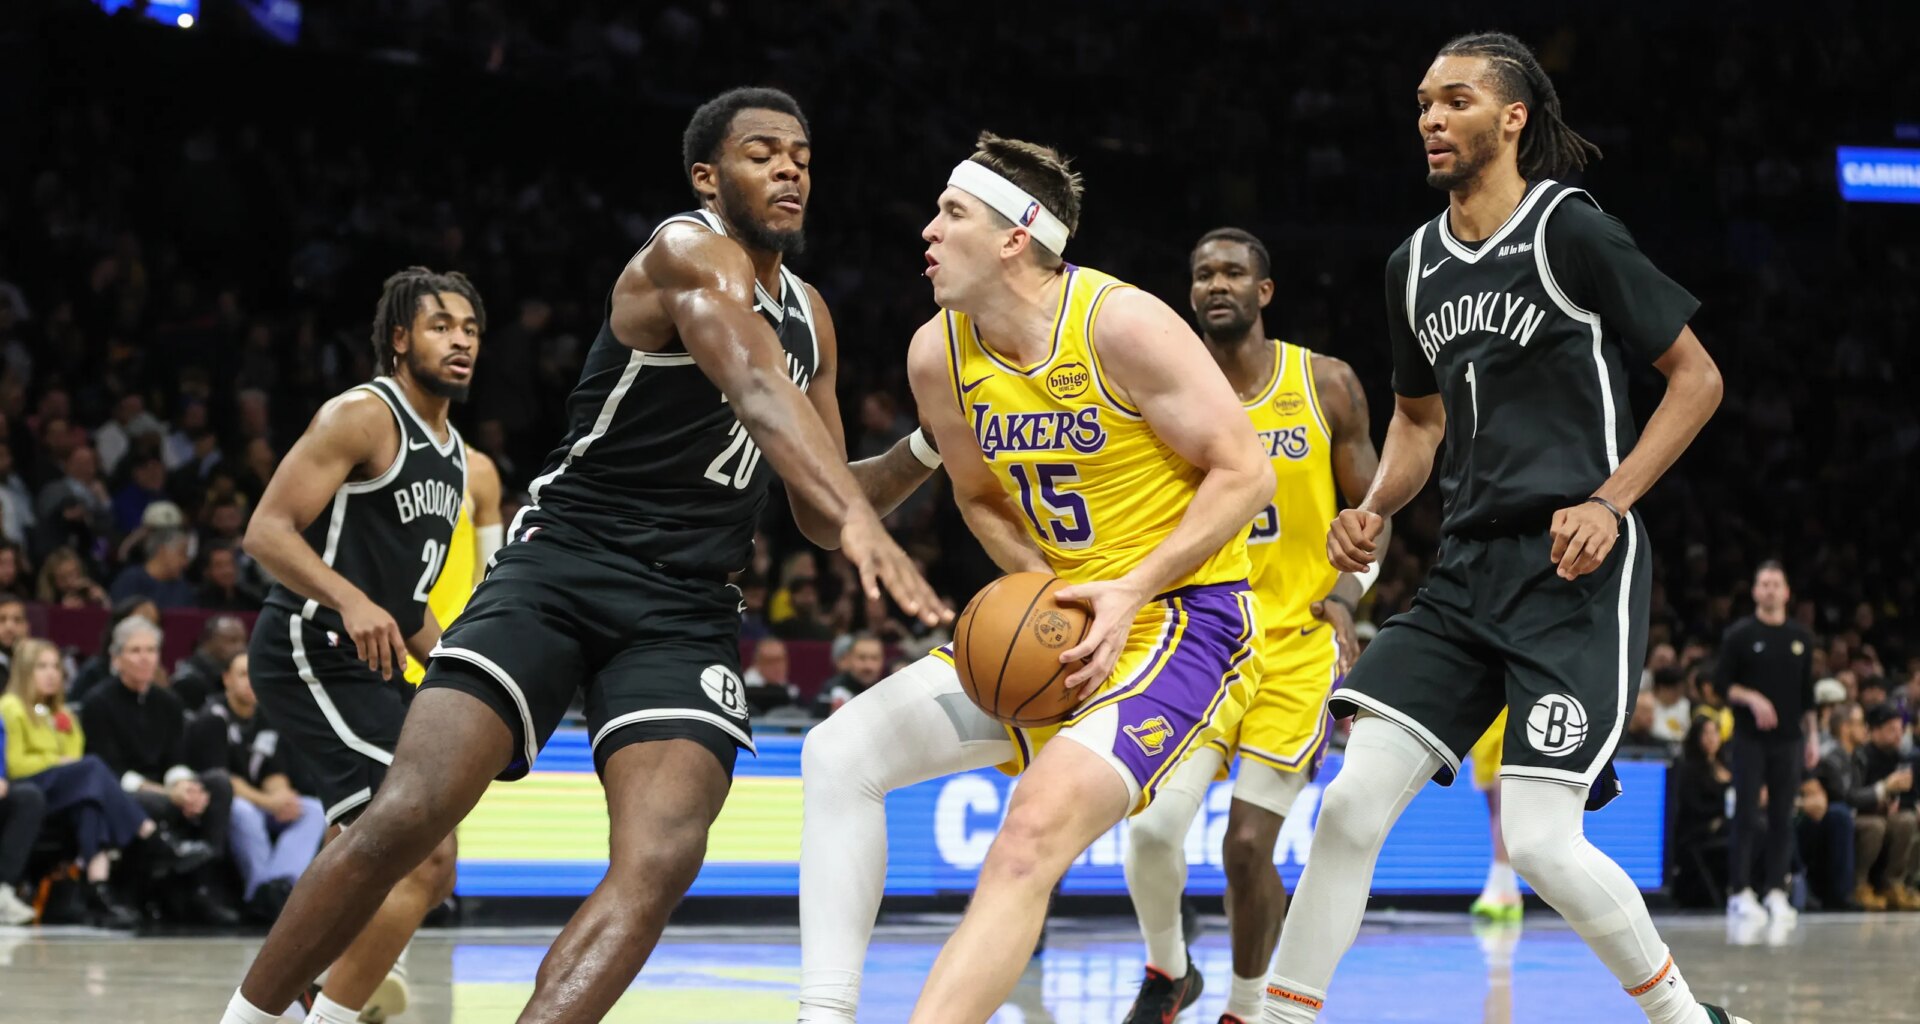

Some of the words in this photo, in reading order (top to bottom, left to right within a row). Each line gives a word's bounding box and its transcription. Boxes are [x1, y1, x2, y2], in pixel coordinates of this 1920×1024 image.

[1418, 292, 1546, 366] BROOKLYN
[1050, 372, 1088, 387] bibigo
[1464, 361, 1478, 439] 1
[703, 418, 762, 490] 20
[971, 402, 1107, 461] LAKERS
[1008, 463, 1097, 549] 15
[721, 672, 737, 711] B
[1544, 701, 1569, 748] B
